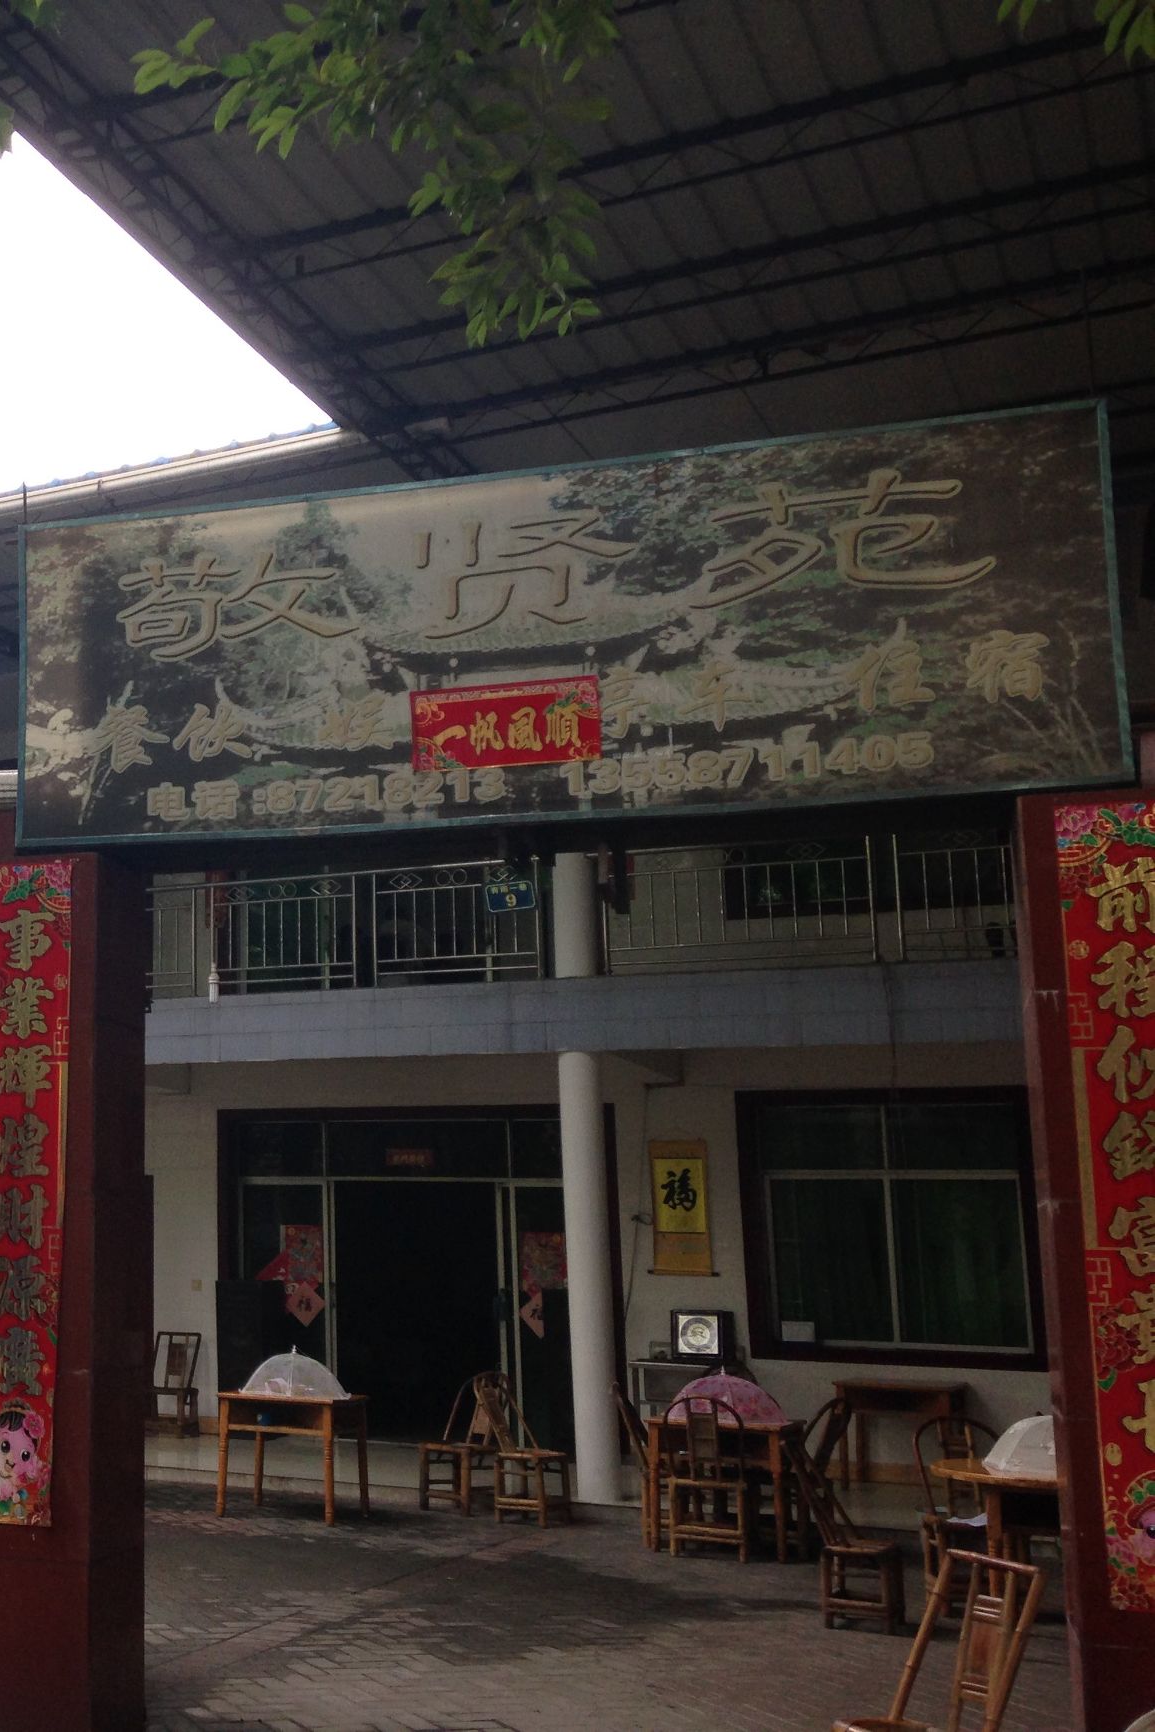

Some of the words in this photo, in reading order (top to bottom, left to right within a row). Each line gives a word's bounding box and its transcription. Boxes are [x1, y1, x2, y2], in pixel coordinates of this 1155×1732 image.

[91, 702, 253, 775] 餐饮
[844, 630, 1050, 713] 住宿
[559, 732, 935, 796] 13558711405
[506, 893, 517, 907] 9
[661, 1168, 697, 1212] 福
